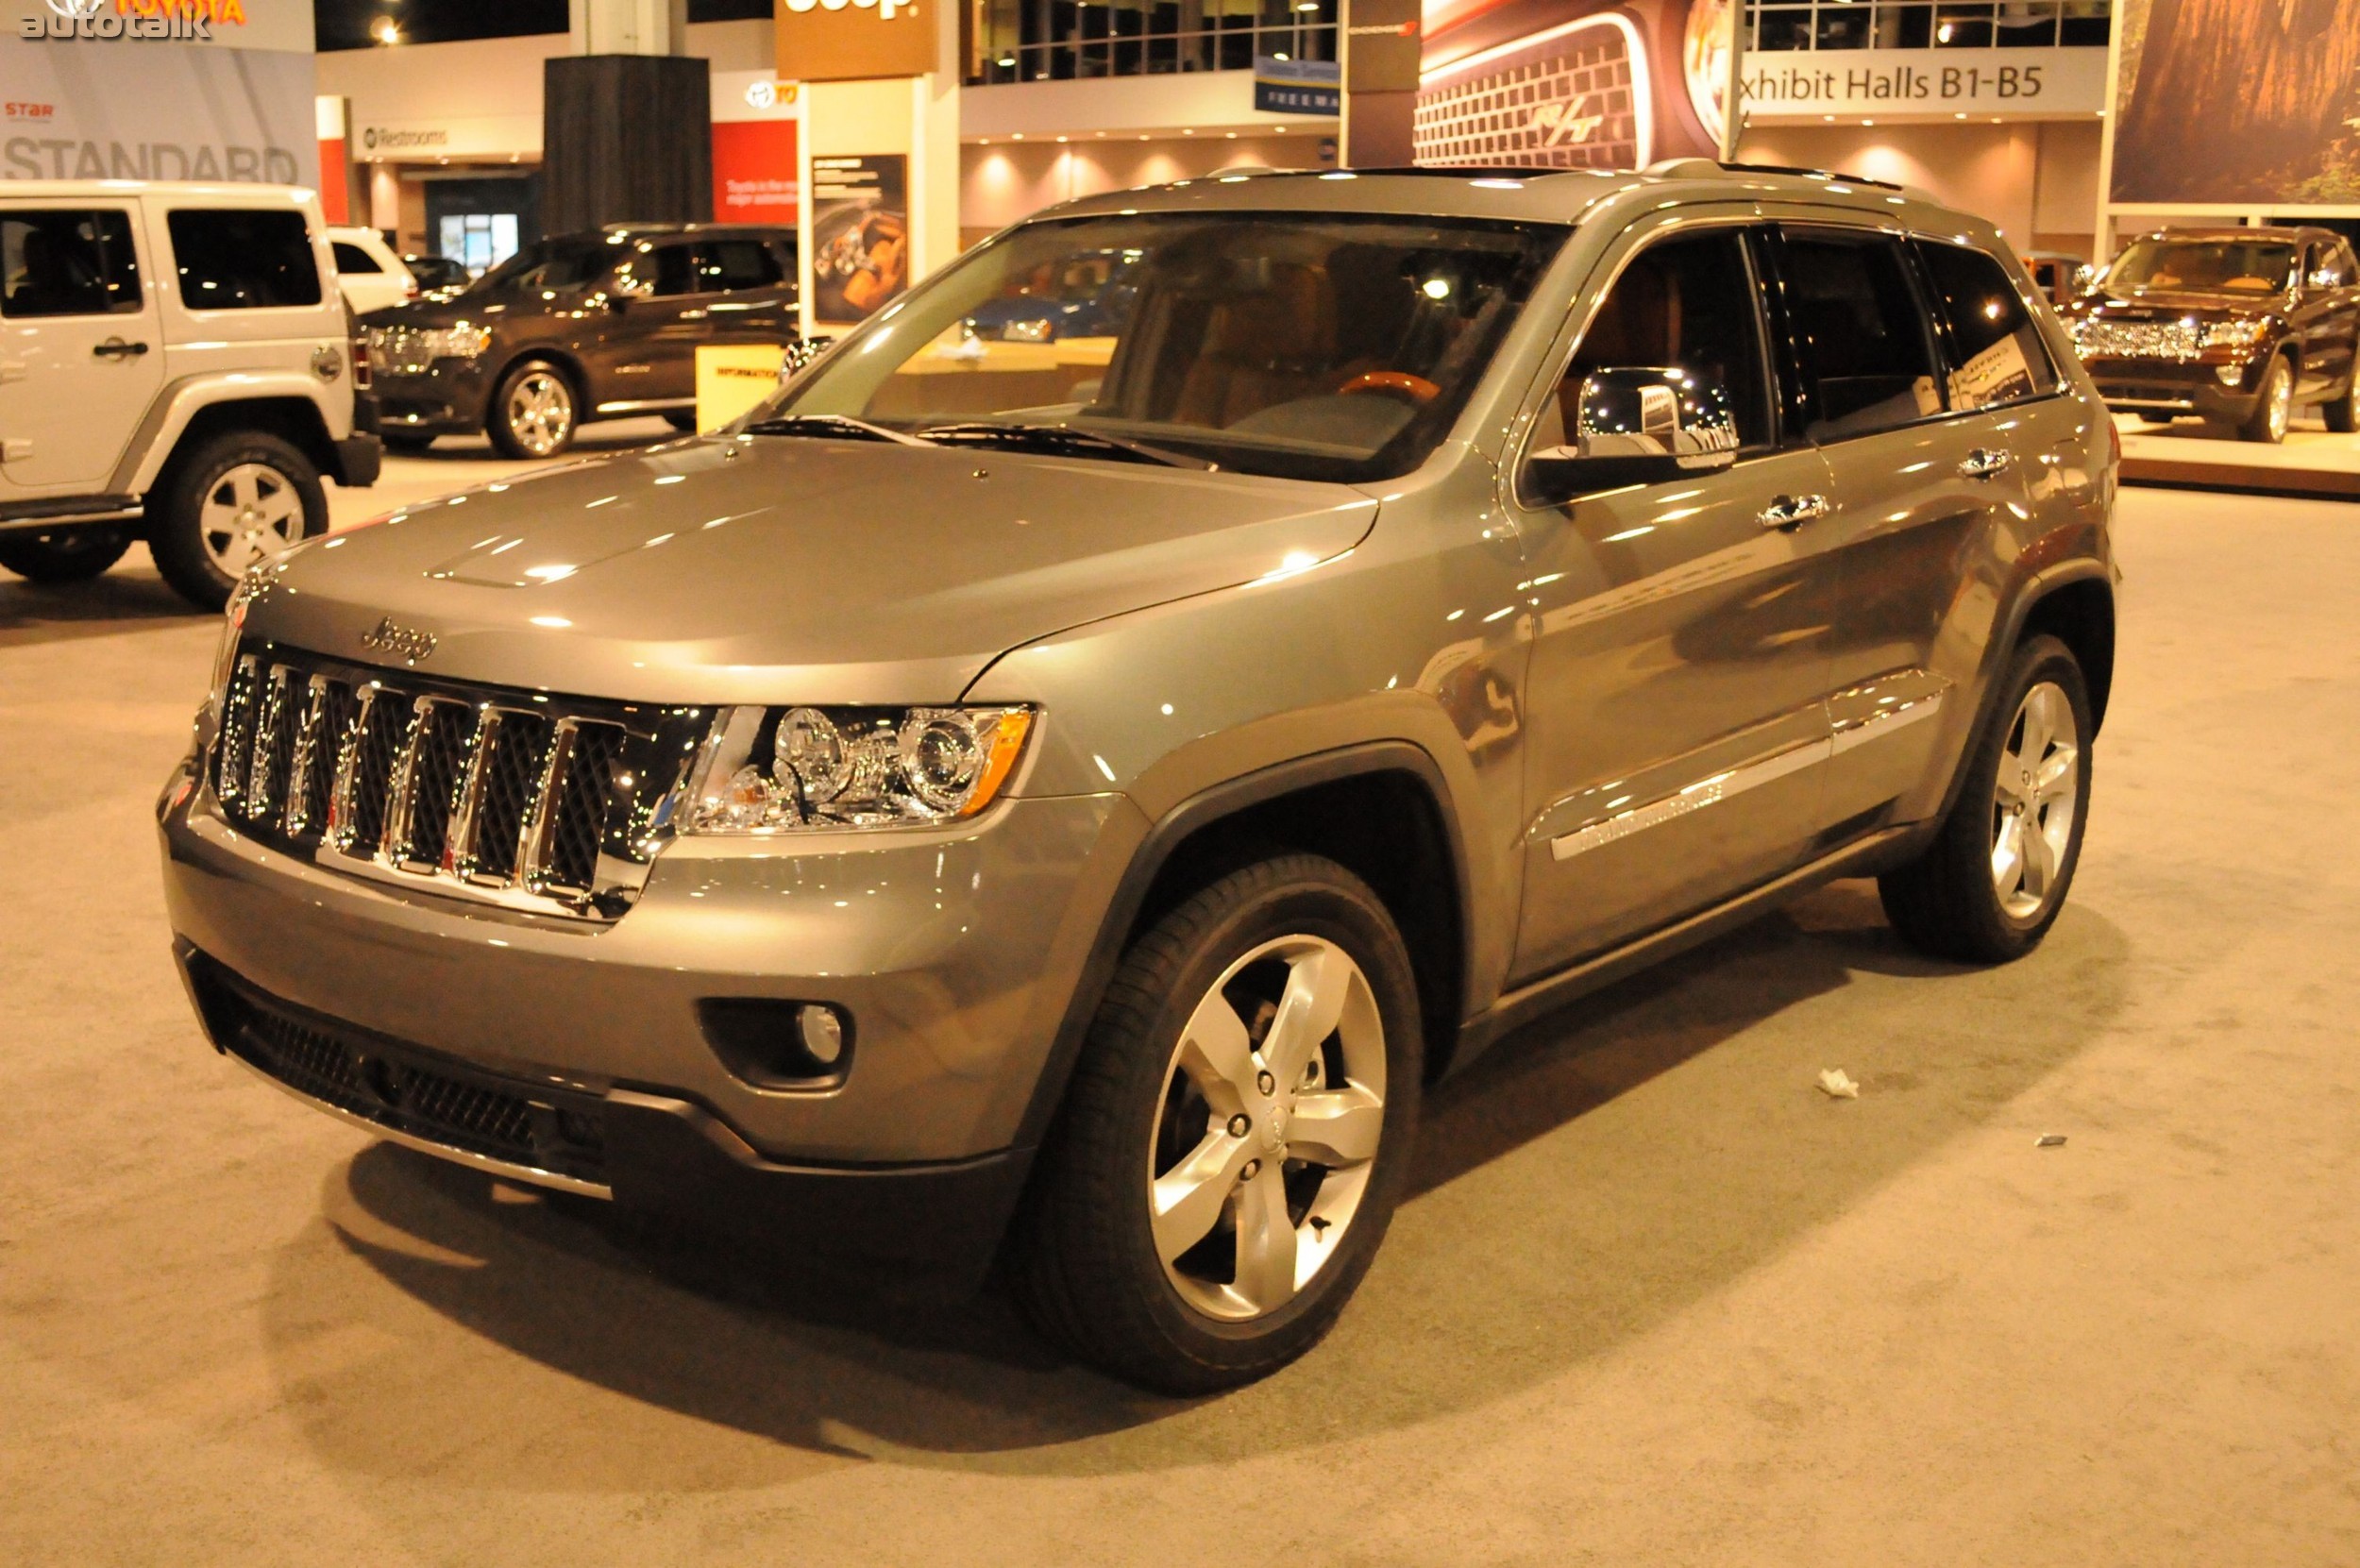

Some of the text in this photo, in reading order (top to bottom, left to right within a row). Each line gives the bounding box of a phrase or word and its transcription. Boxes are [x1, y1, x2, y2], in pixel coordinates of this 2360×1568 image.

[114, 0, 246, 25] TOYOTA
[1268, 92, 1340, 107] FREEMA
[1740, 66, 2043, 100] xhibit Halls B1-B5
[1529, 95, 1603, 146] R/T
[4, 137, 299, 184] STANDARD
[362, 615, 437, 666] Jeep
